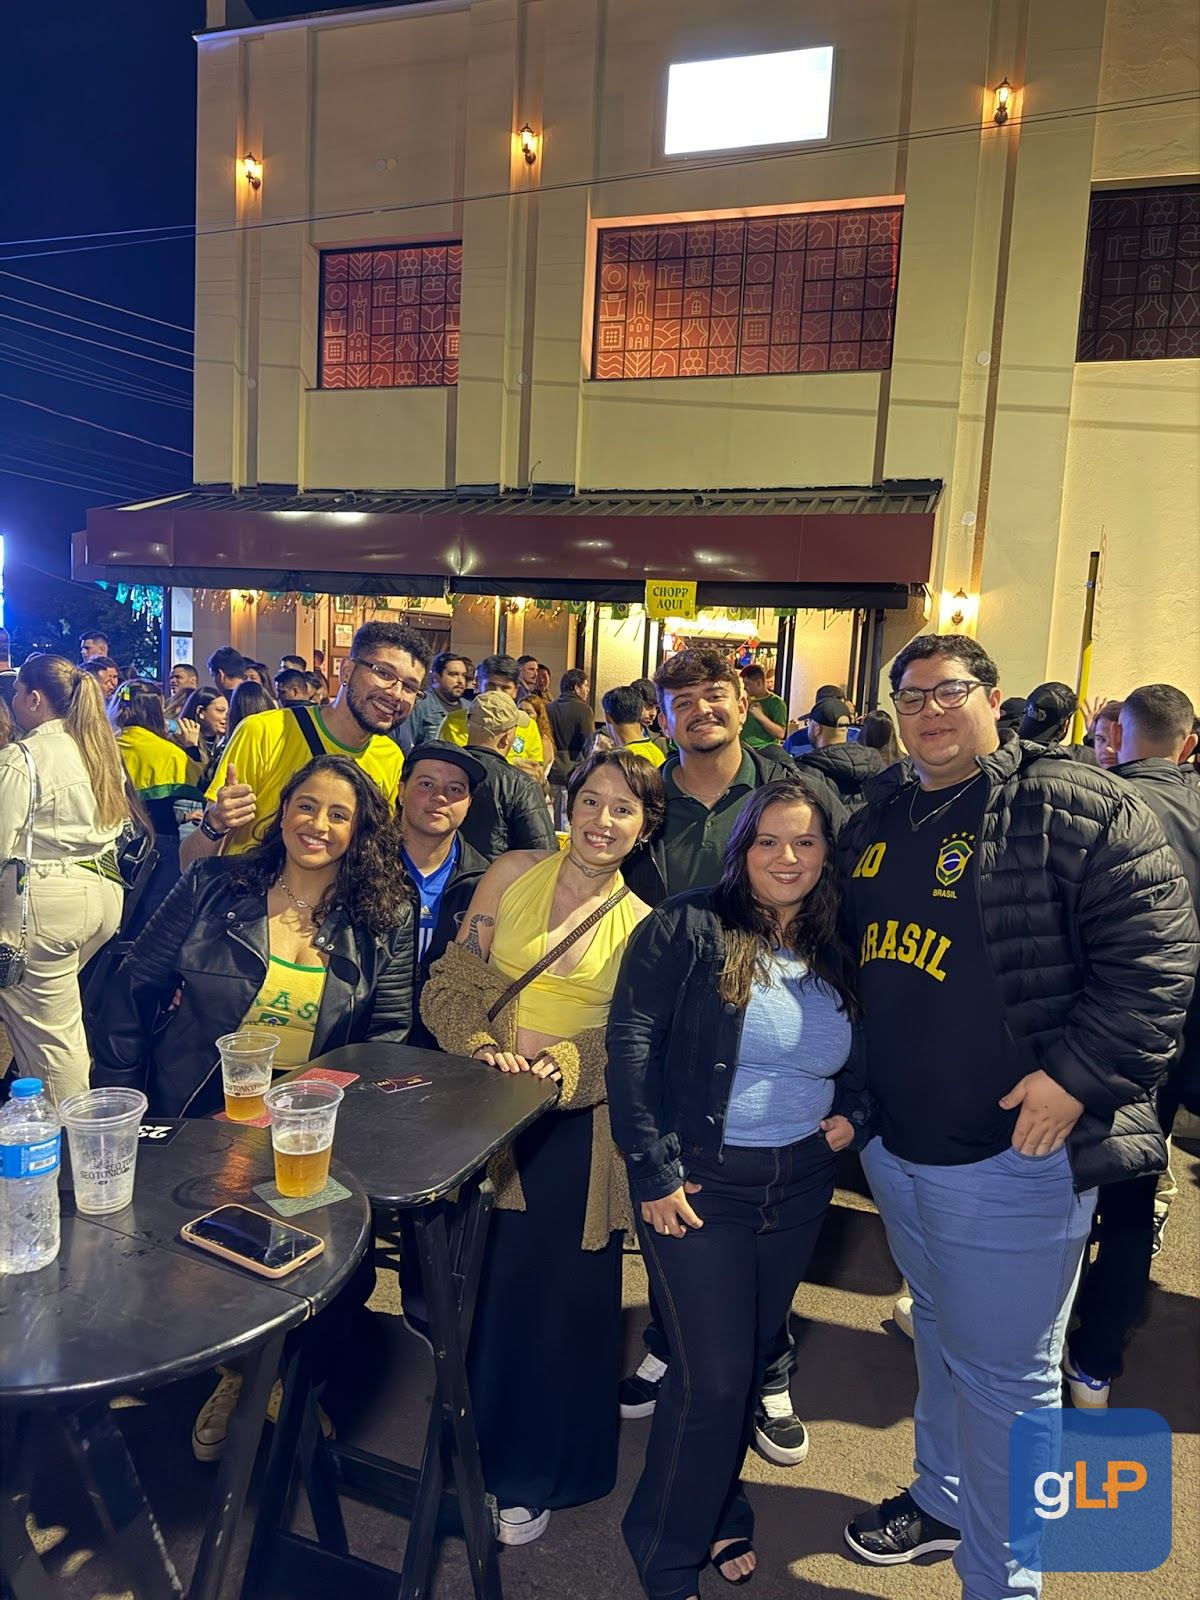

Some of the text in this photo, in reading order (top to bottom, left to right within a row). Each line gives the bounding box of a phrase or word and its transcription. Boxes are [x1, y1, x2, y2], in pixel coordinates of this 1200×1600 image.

[653, 586, 689, 598] CHOPP
[657, 599, 683, 611] AQUI
[932, 889, 958, 899] BRASIL
